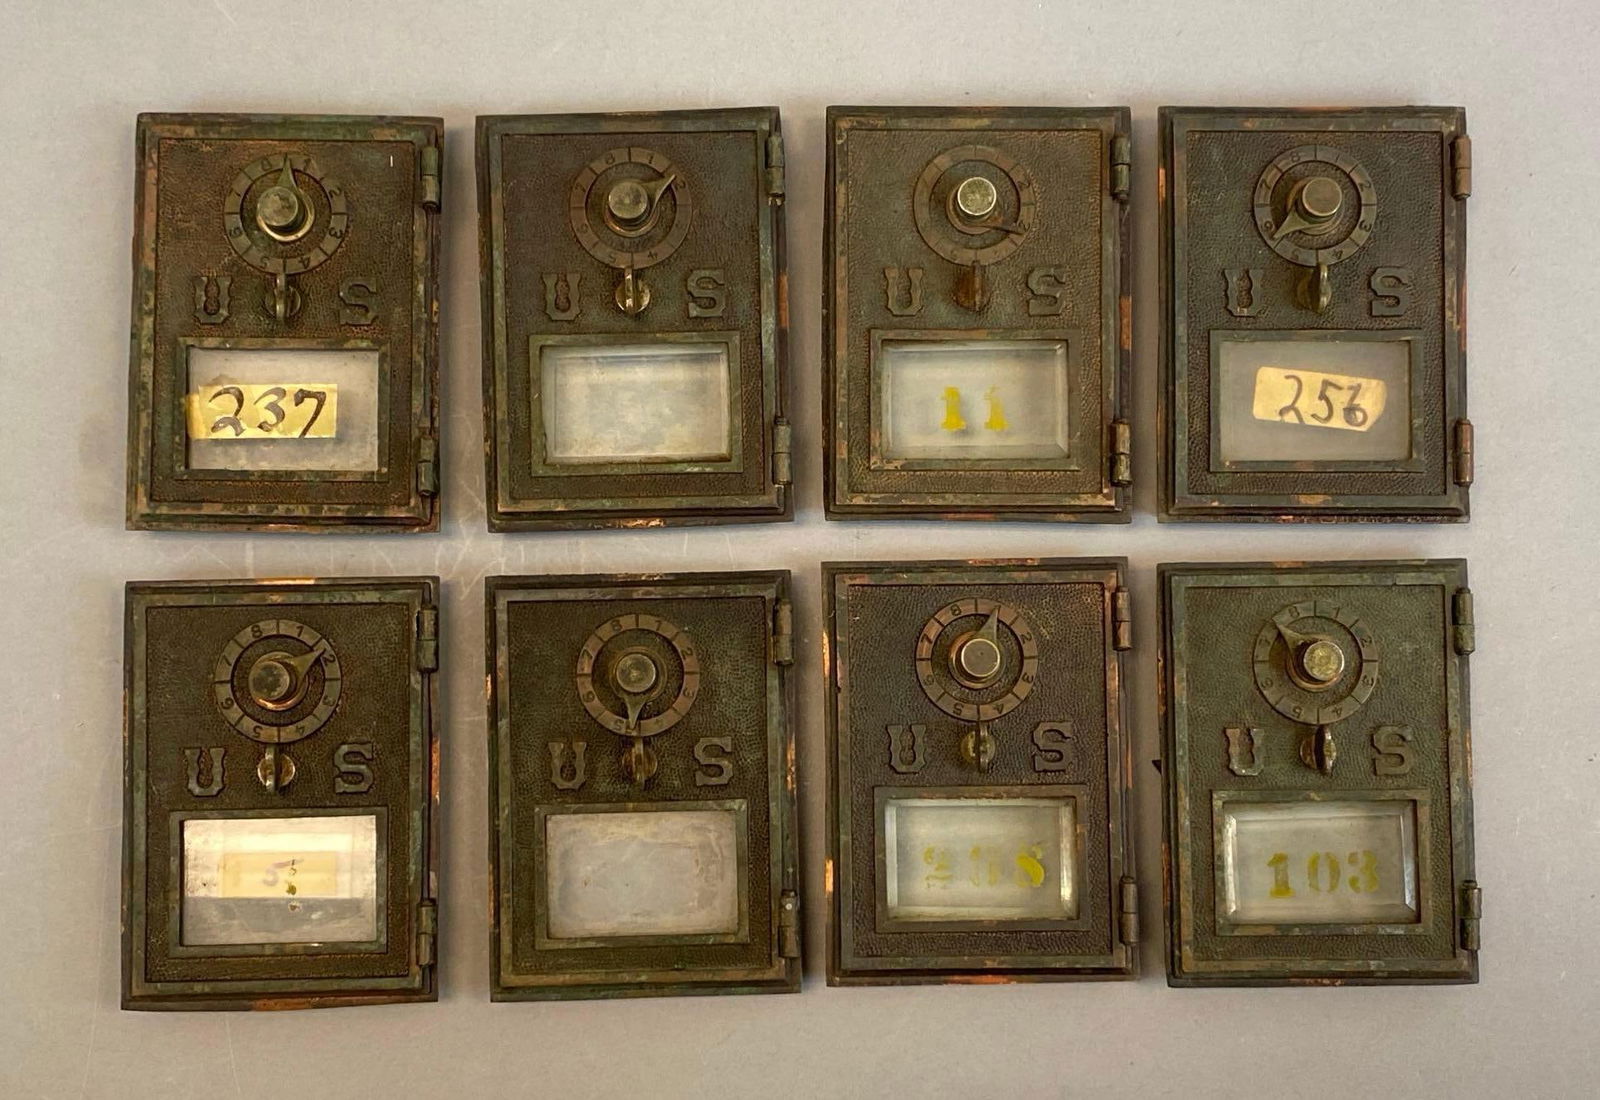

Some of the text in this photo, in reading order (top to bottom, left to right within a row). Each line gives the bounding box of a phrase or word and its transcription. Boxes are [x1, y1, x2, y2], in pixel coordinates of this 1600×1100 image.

[328, 227, 343, 239] 3
[1359, 219, 1372, 232] 3
[194, 276, 377, 326] U S
[541, 269, 725, 321] U S
[883, 267, 1066, 317] U S
[1223, 267, 1411, 317] U S
[208, 386, 327, 438] 237
[221, 696, 235, 710] 6
[250, 624, 263, 638] 8
[184, 742, 374, 797] U S
[548, 736, 733, 790] U S
[886, 721, 1075, 775] U S
[1224, 725, 1413, 777] U S
[1267, 850, 1380, 898] 103
